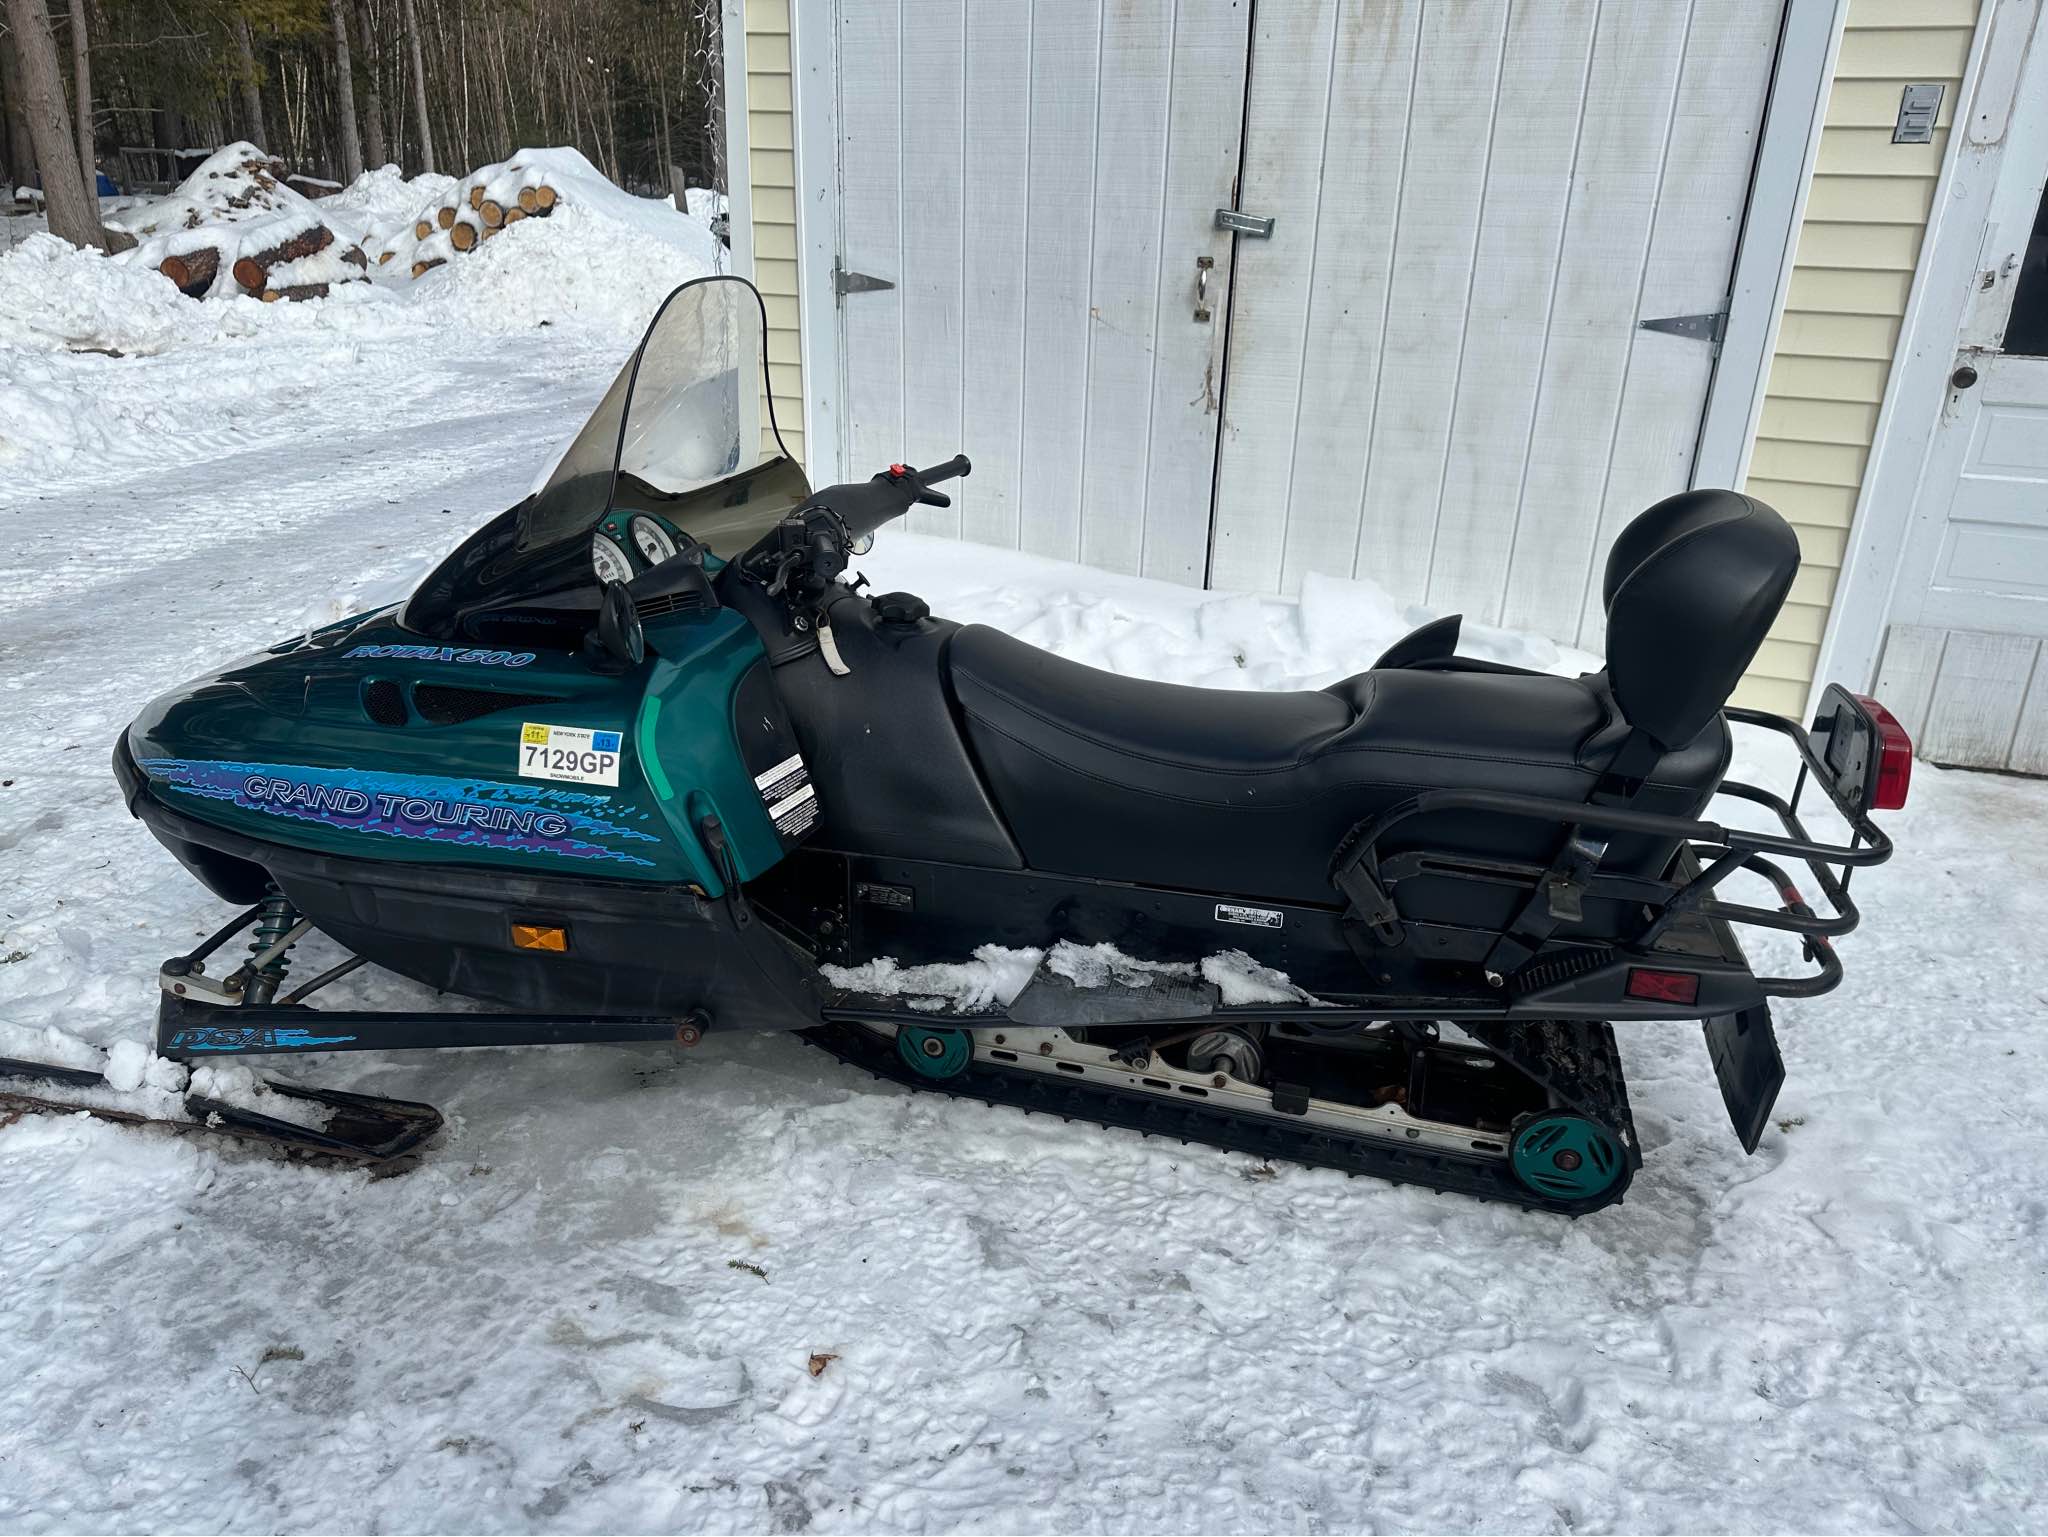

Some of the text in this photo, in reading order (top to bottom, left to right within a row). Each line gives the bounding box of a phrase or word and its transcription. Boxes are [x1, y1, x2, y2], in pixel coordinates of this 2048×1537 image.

[341, 645, 537, 667] ROTAX 500
[577, 732, 591, 740] STATE
[525, 745, 615, 775] 7129GP
[549, 772, 585, 781] SNOWMOBILE
[242, 775, 568, 836] GRAND TOURING
